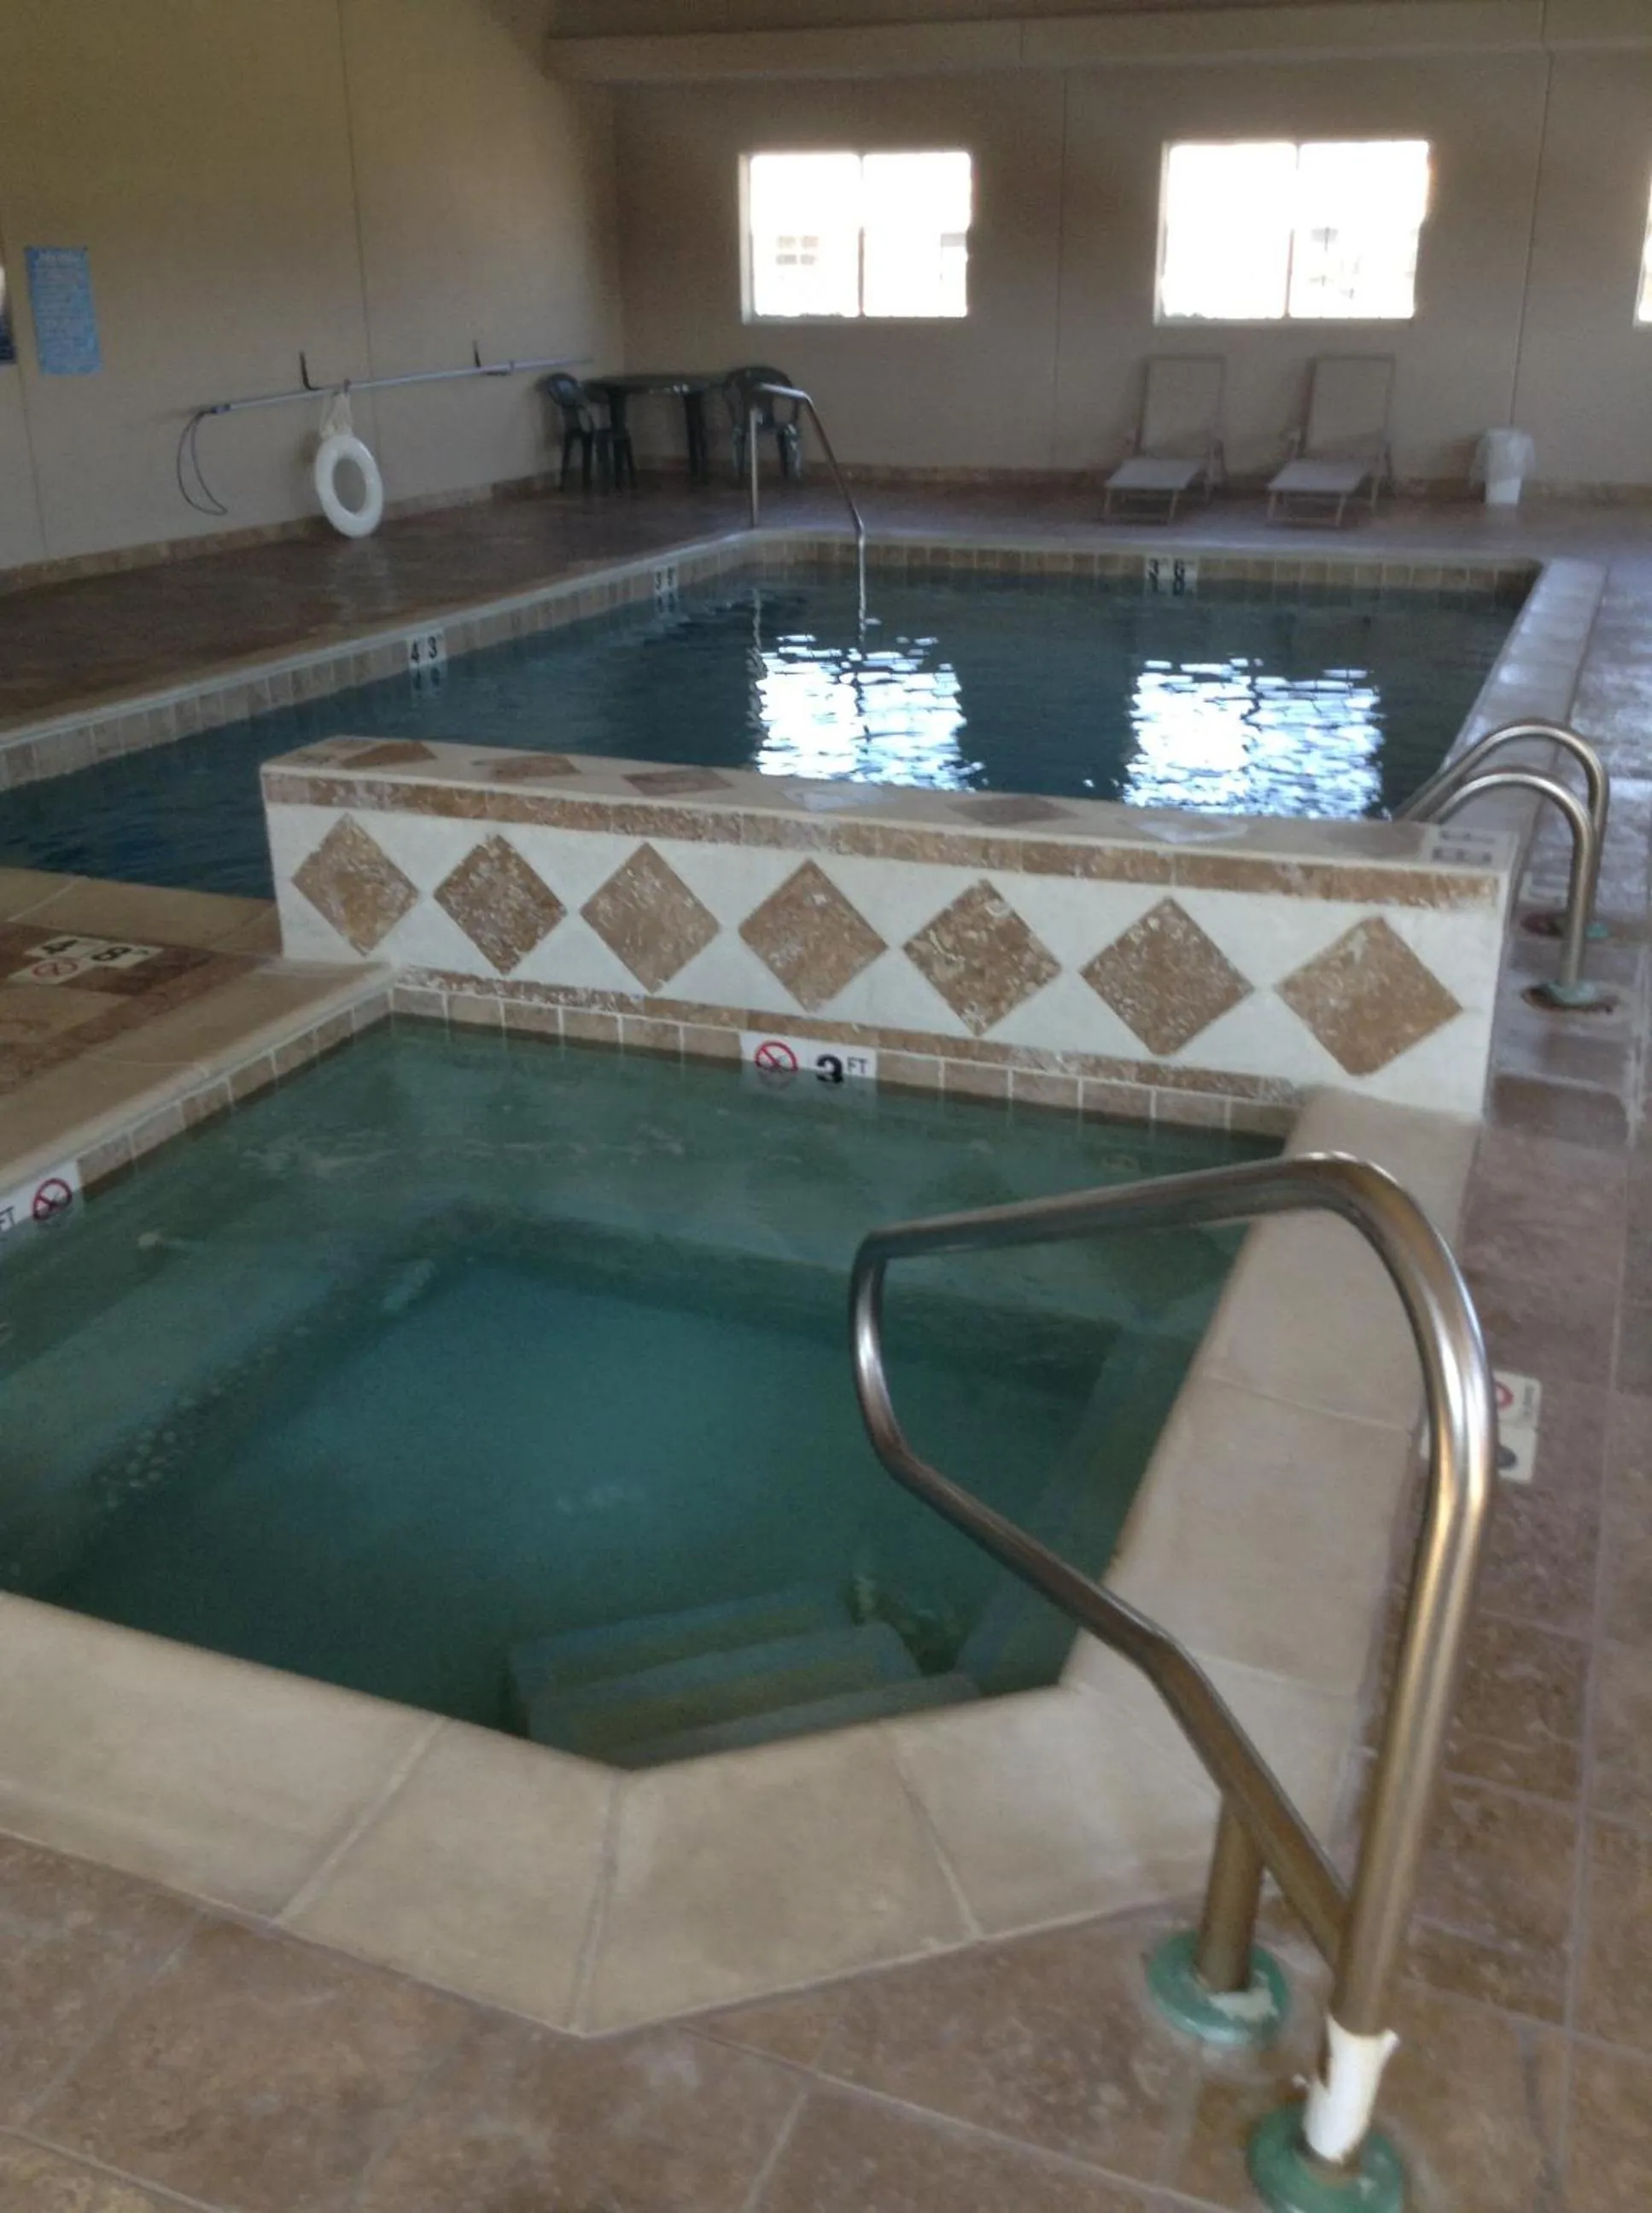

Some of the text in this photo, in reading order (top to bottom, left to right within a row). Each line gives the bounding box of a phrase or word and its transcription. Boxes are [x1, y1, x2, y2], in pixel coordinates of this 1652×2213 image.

[411, 639, 420, 663] 4
[428, 636, 438, 659] 3
[90, 946, 132, 962] 8
[816, 1054, 869, 1083] 3 FT
